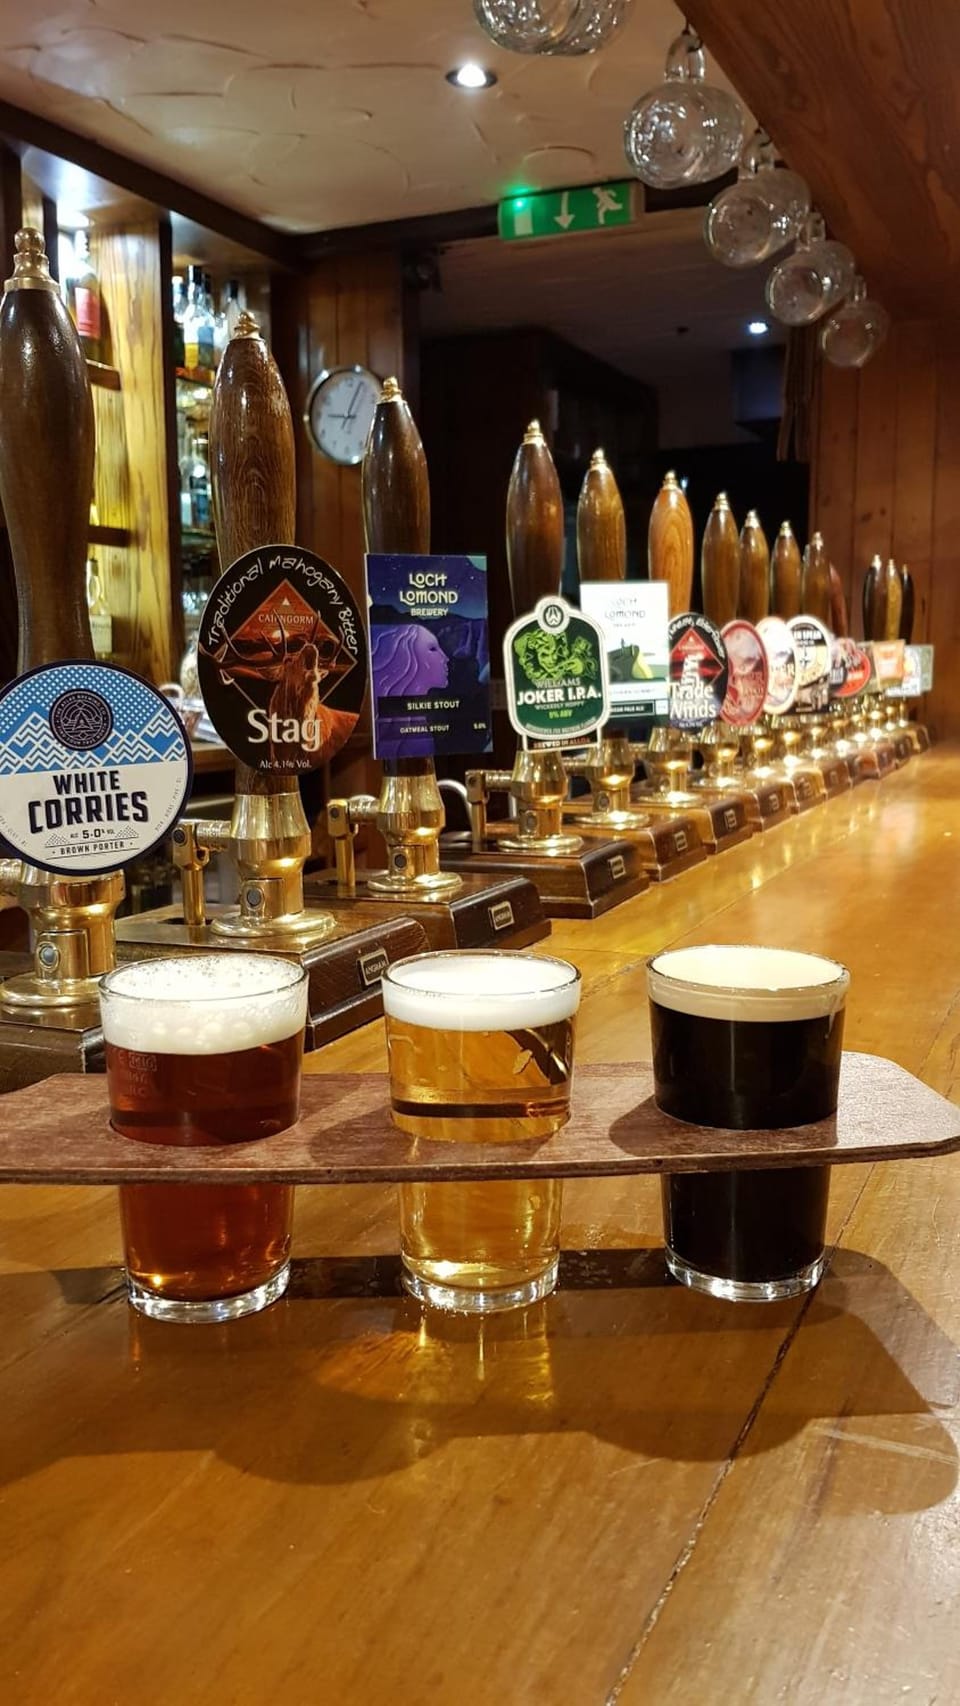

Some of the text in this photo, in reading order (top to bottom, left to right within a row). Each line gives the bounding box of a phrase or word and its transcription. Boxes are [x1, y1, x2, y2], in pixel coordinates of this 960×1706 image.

[409, 573, 448, 588] LOCH
[208, 555, 358, 655] Traditional Mahogany Bitter
[399, 590, 458, 606] LOMOND
[410, 607, 449, 617] BREWERY
[534, 678, 581, 688] WILLIAMS
[669, 681, 714, 700] Trade
[517, 688, 565, 706] JOKER
[568, 685, 602, 701] I.P.A.
[407, 700, 460, 711] SILKIE STOUT
[247, 709, 323, 751] Stag
[430, 724, 449, 732] STOUT
[260, 759, 272, 768] Alc
[296, 759, 312, 768] Vol.
[53, 769, 121, 796] WHITE
[28, 791, 149, 834] CORRIES
[60, 840, 124, 855] BROWN PORTER
